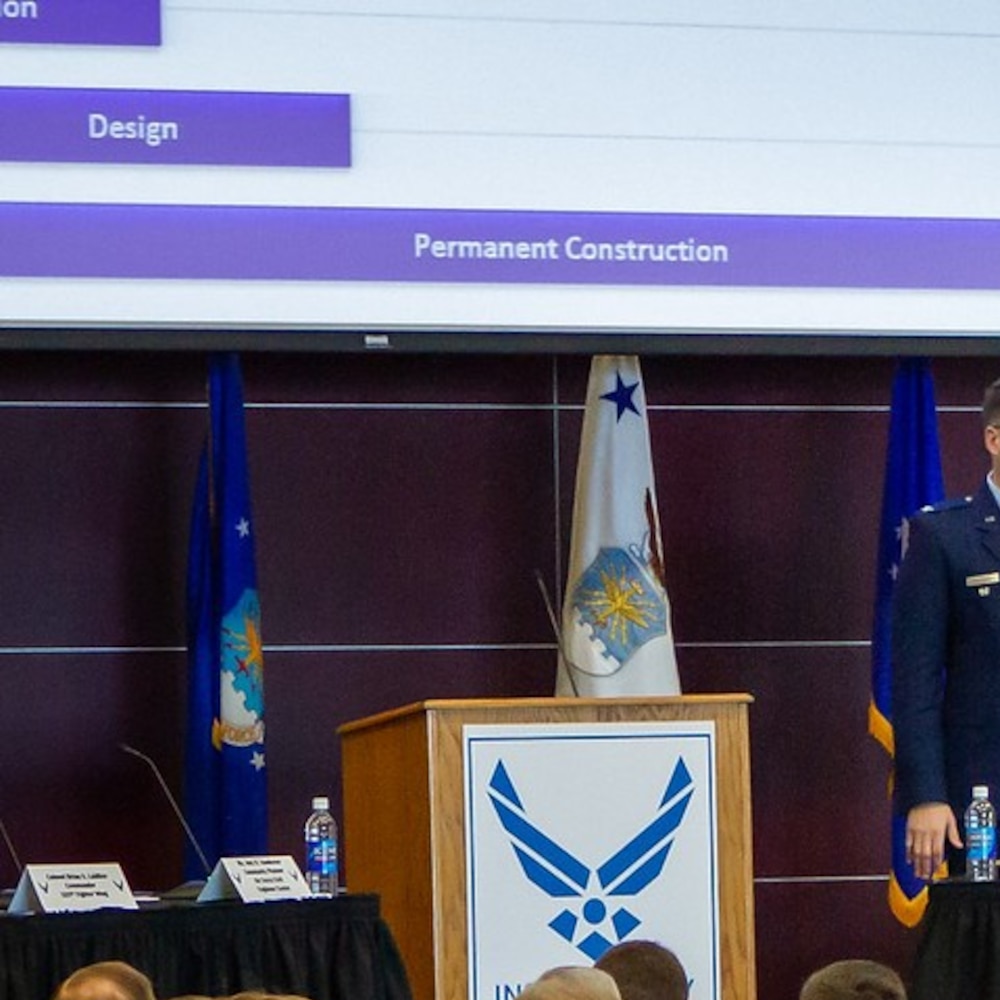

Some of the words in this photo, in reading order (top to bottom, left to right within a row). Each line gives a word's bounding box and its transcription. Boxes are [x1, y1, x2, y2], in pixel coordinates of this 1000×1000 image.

[0, 0, 38, 18] on
[88, 113, 178, 147] Design
[414, 233, 559, 260] Permanent
[565, 236, 728, 262] Construction
